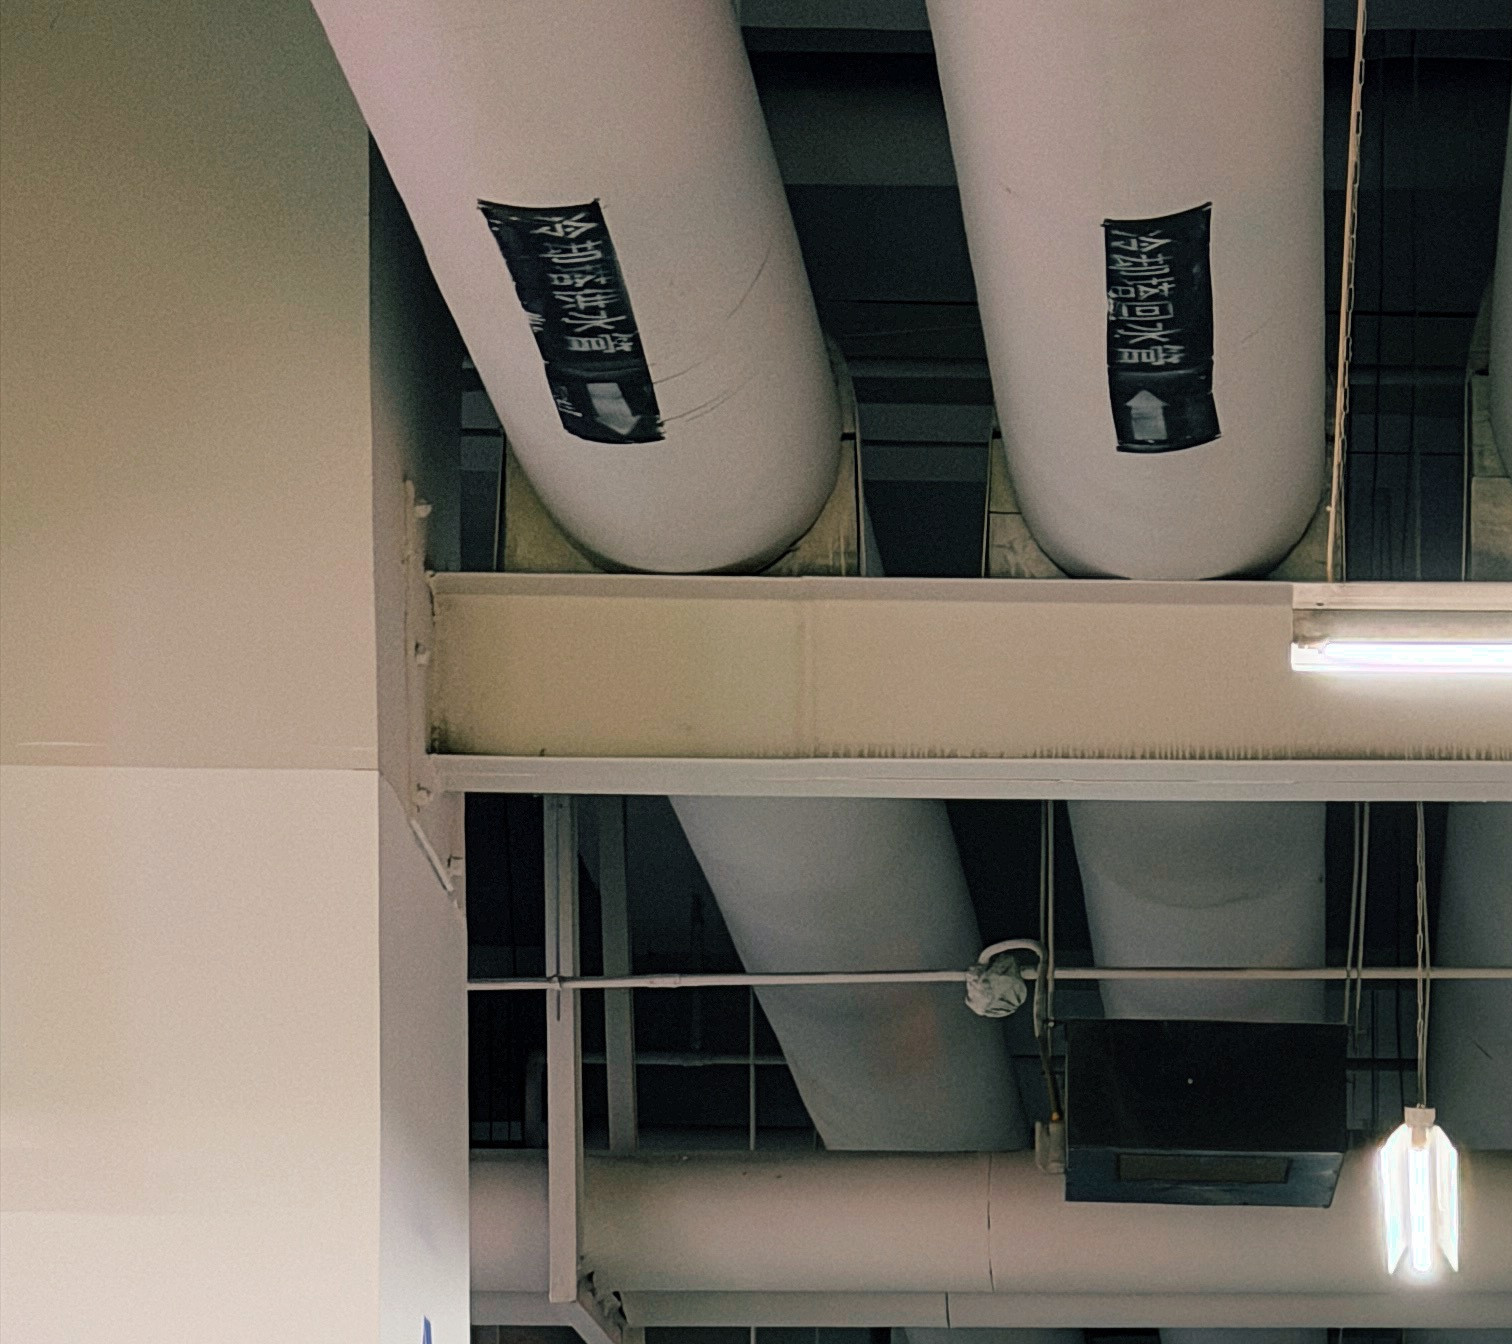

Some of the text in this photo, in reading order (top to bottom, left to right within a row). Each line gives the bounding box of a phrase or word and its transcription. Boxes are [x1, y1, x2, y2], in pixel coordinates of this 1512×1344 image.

[1108, 229, 1185, 364] 冷却塔回水管
